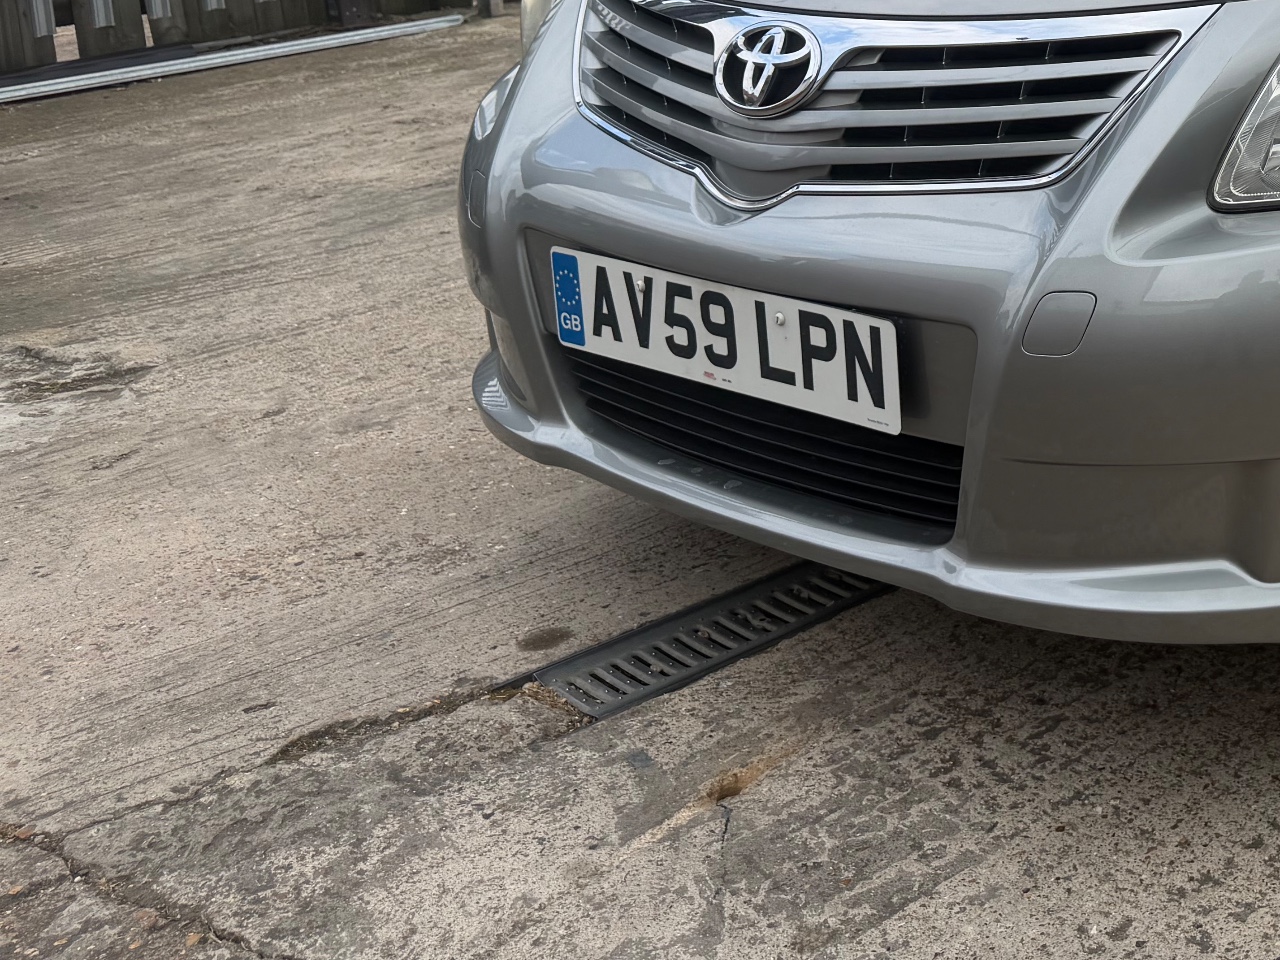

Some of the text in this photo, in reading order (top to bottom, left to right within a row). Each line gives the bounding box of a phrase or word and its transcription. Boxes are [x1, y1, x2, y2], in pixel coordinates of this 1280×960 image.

[560, 311, 582, 332] GB
[592, 265, 886, 410] AV59 LPN
